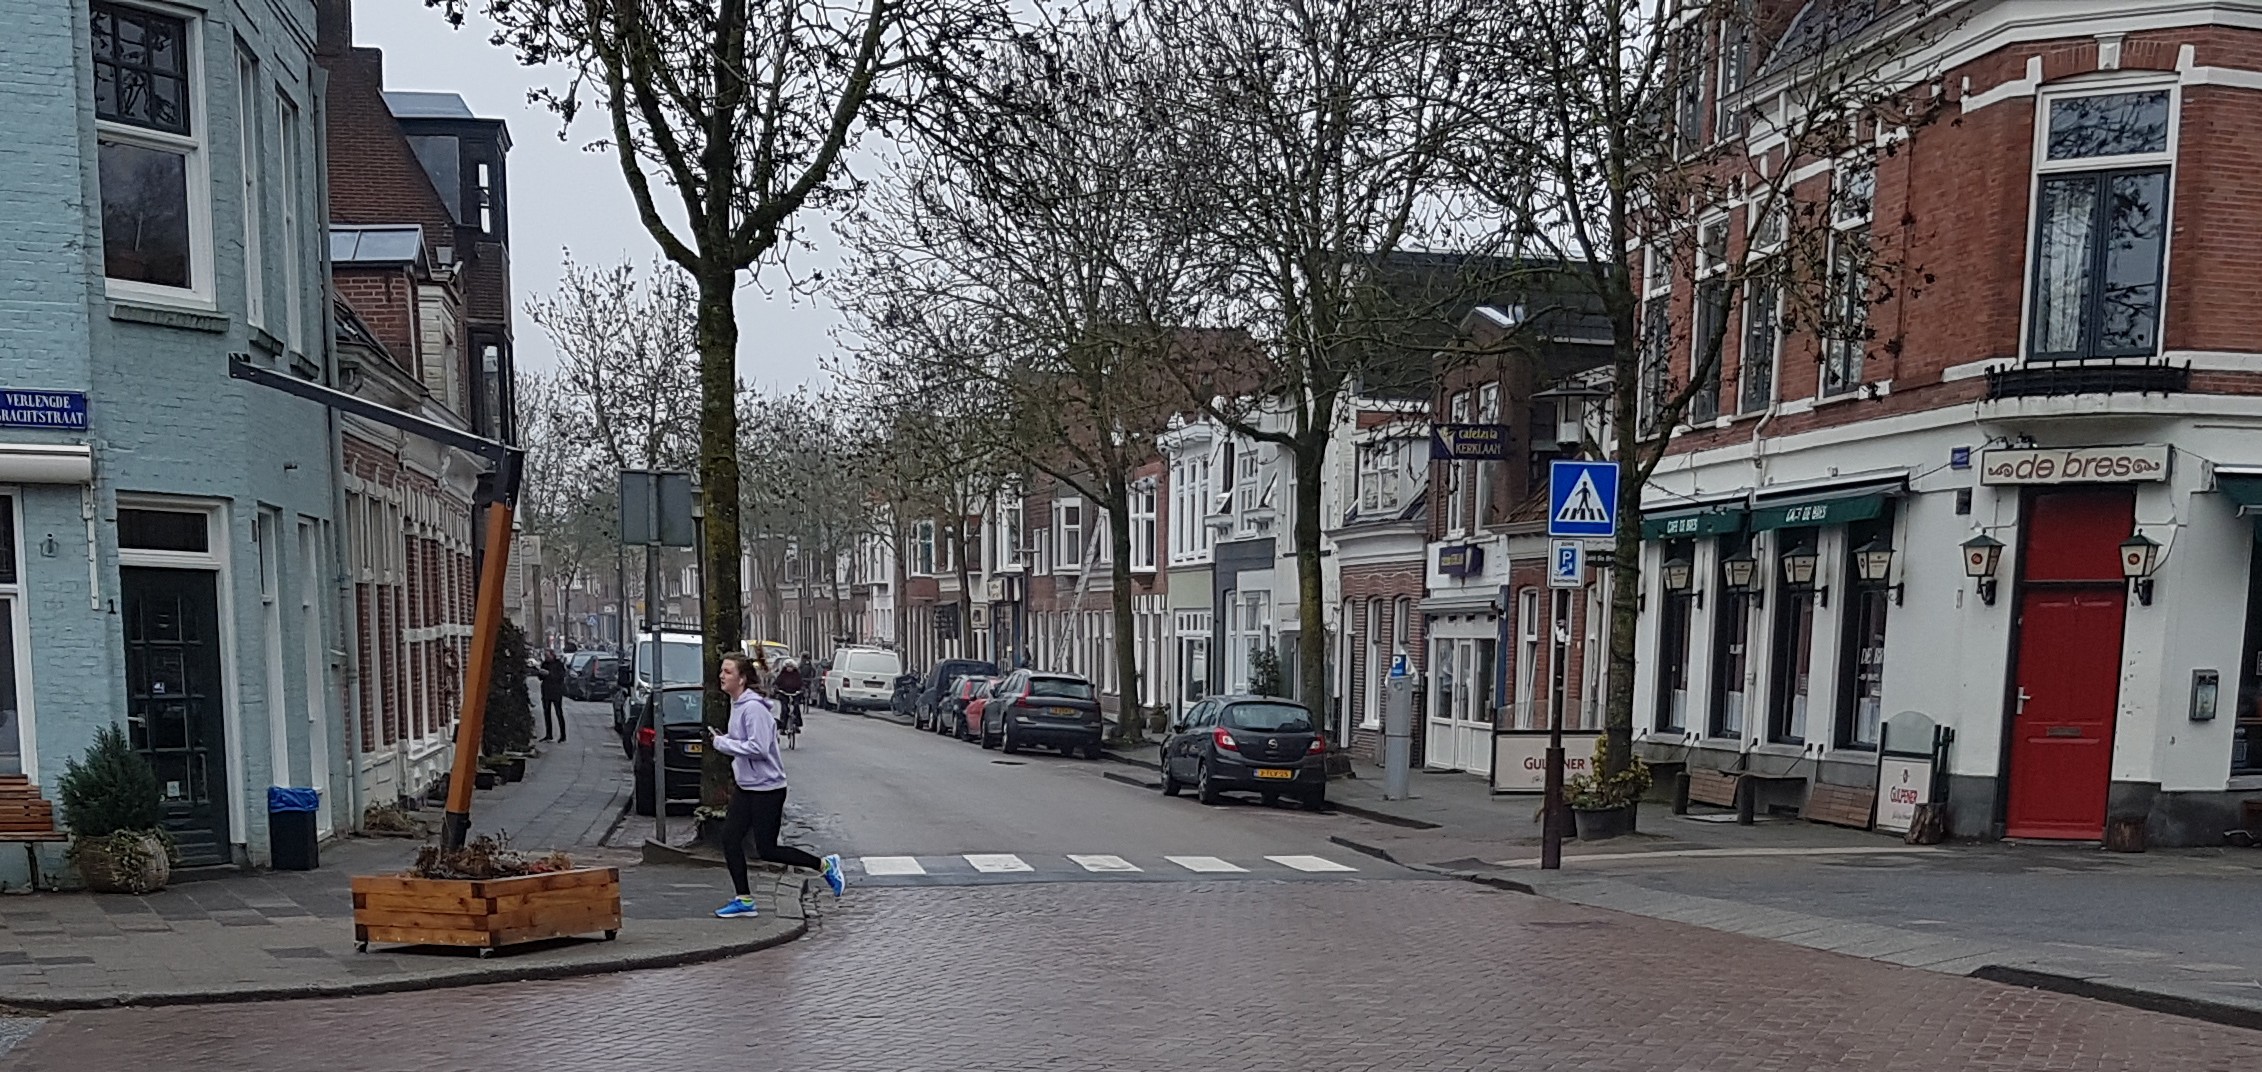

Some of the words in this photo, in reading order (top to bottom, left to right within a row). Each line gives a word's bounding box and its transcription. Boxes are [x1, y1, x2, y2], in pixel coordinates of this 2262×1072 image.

[6, 393, 71, 409] VERLENGDE
[2015, 453, 2055, 480] de
[2061, 451, 2132, 478] bres
[1562, 550, 1573, 565] P
[107, 598, 117, 615] 1
[1392, 655, 1402, 668] P
[1524, 756, 1586, 770] GULNER
